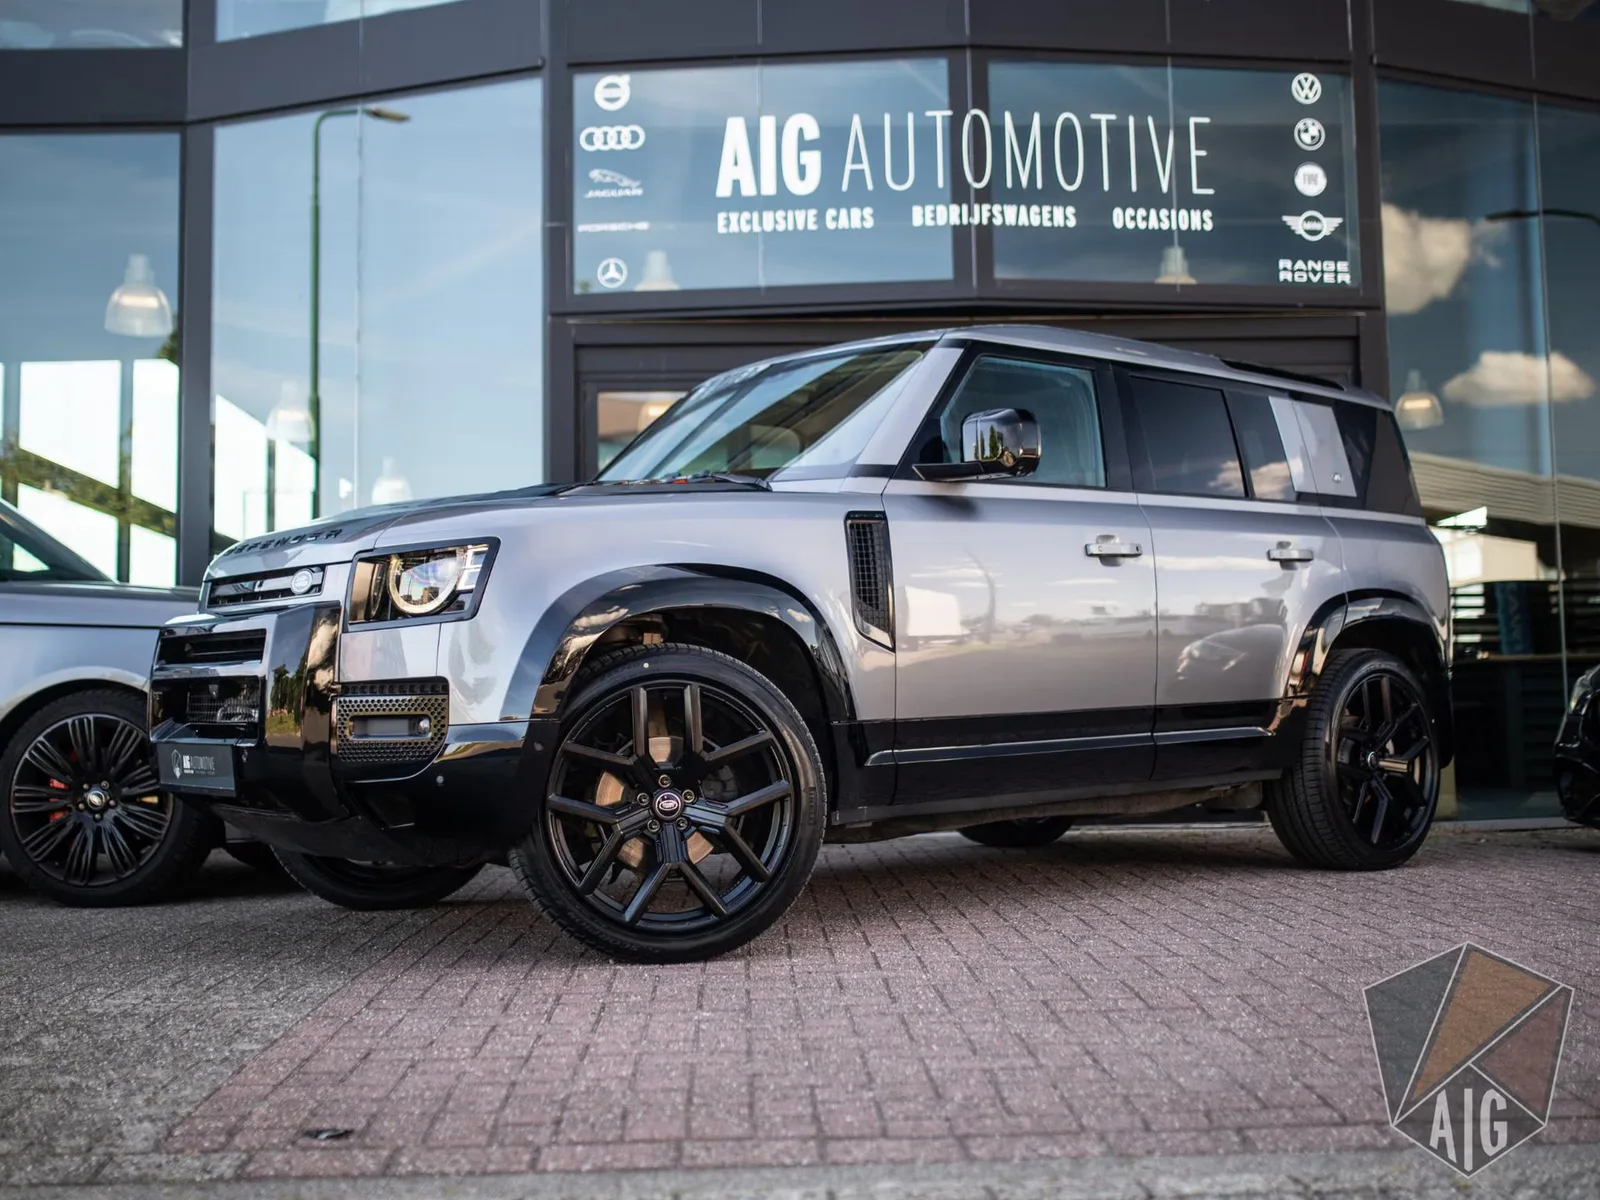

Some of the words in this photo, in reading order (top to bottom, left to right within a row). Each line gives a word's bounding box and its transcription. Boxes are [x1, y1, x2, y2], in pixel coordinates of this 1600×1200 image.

[715, 112, 822, 198] AIG
[841, 108, 1215, 196] AUTOMOTIVE
[716, 208, 819, 234] EXCLUSIVE
[825, 206, 875, 230] CARS
[911, 203, 1077, 228] BEDRIJFSWAGENS
[1112, 207, 1213, 232] OCCASIONS
[1278, 258, 1350, 272] RANGE
[1278, 270, 1352, 285] ROVER
